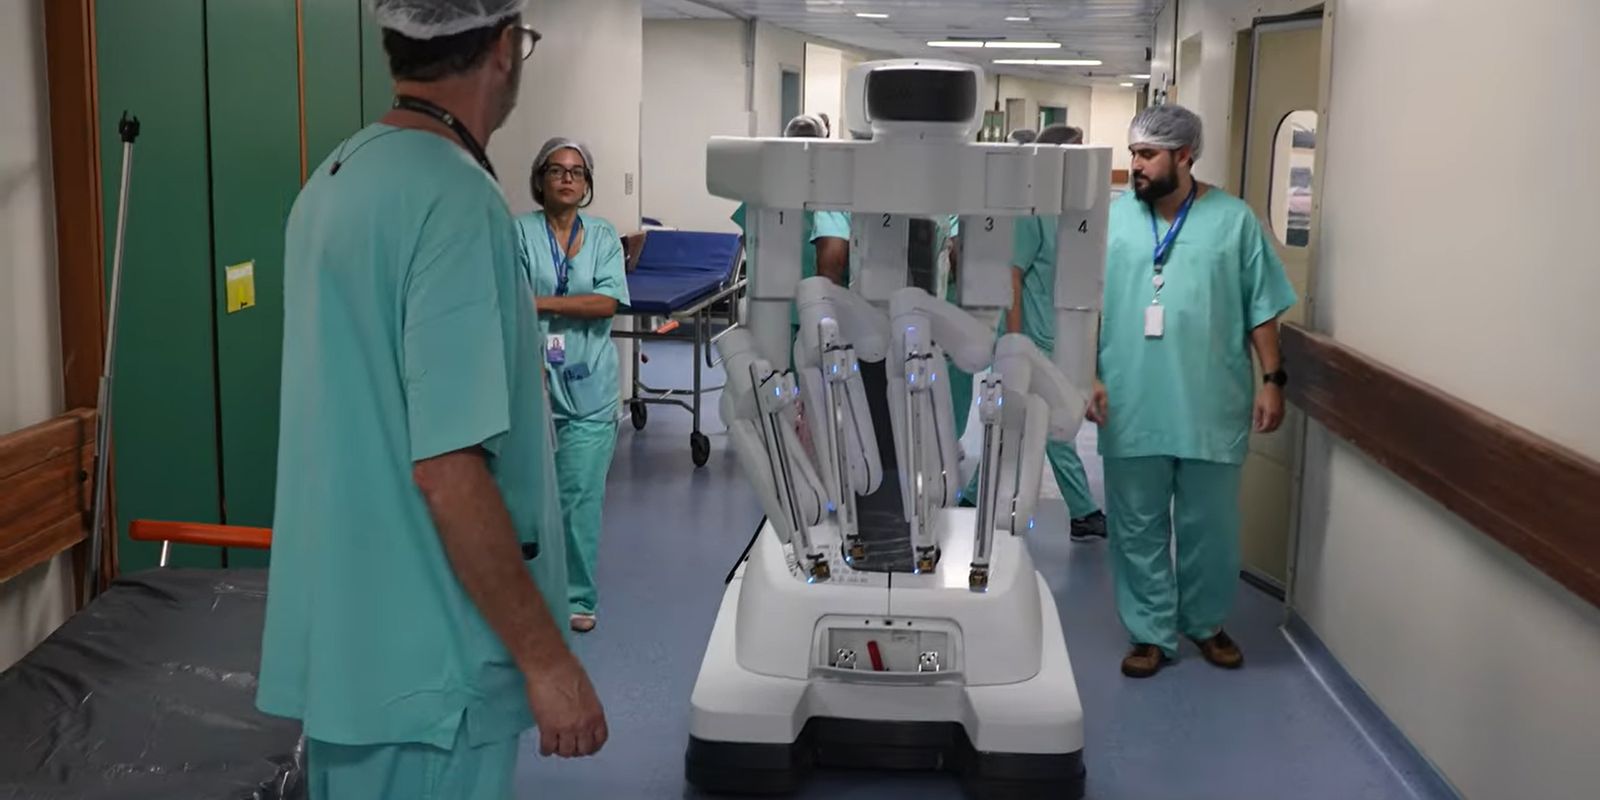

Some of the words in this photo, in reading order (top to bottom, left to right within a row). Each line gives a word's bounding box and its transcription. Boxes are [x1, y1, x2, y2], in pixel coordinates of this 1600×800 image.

[779, 211, 784, 225] 1
[882, 213, 892, 228] 2
[984, 216, 994, 232] 3
[1077, 219, 1088, 234] 4
